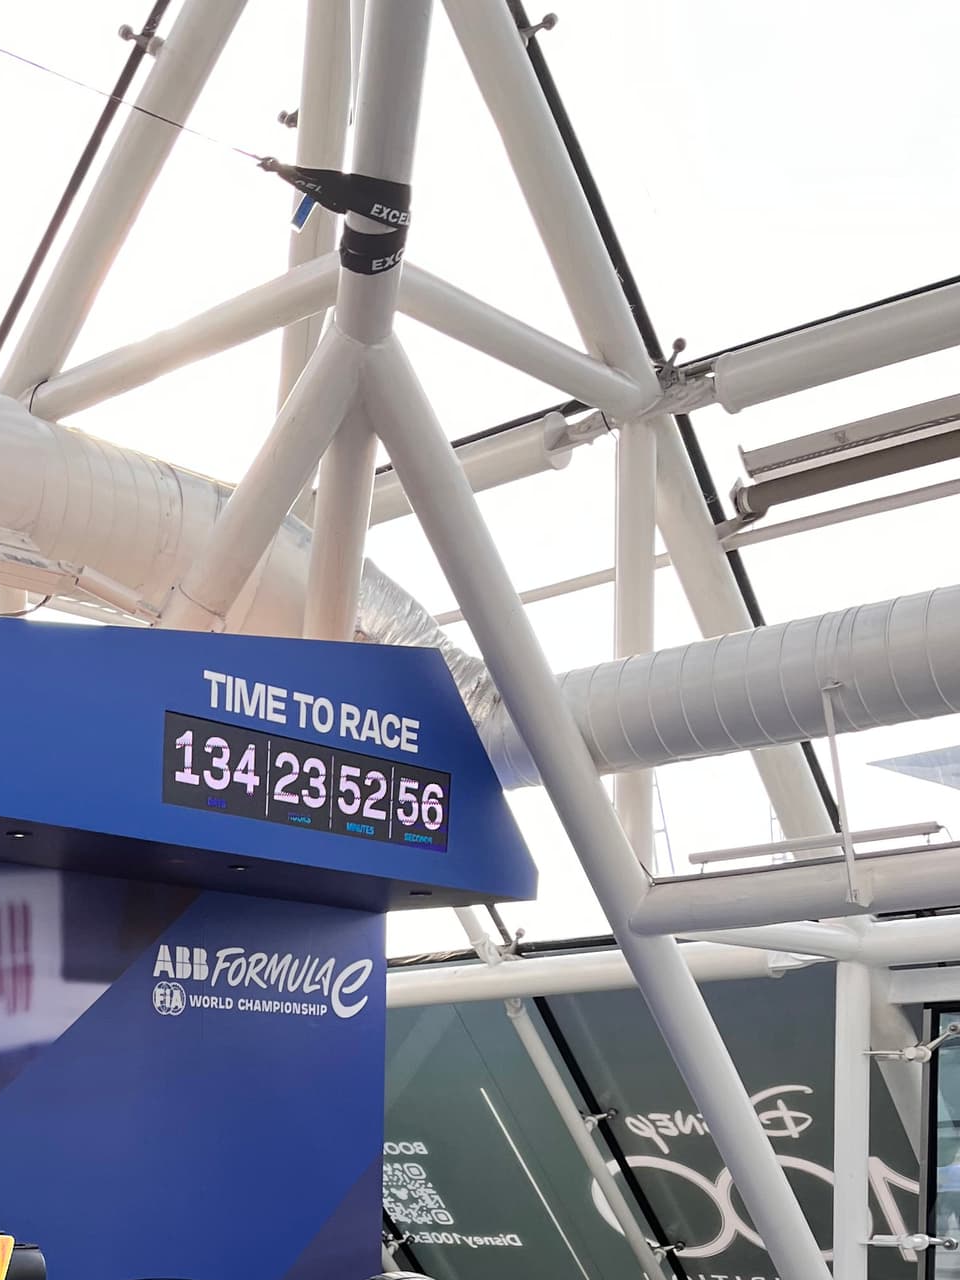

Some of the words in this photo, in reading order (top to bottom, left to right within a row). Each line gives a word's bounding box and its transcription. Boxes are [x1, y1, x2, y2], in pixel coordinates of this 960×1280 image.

[203, 669, 288, 724] TIME
[293, 692, 334, 733] TO
[340, 703, 420, 753] RACE
[175, 730, 260, 798] 134
[273, 752, 327, 808] 23
[338, 765, 387, 820] 52
[397, 777, 443, 830] 56
[346, 822, 375, 836] MINUTES
[153, 944, 209, 981] ABB
[211, 947, 336, 997] FORMULA
[154, 984, 186, 1011] FIA
[189, 994, 233, 1010] WORLD
[237, 998, 328, 1017] CHAMPIONSHIP
